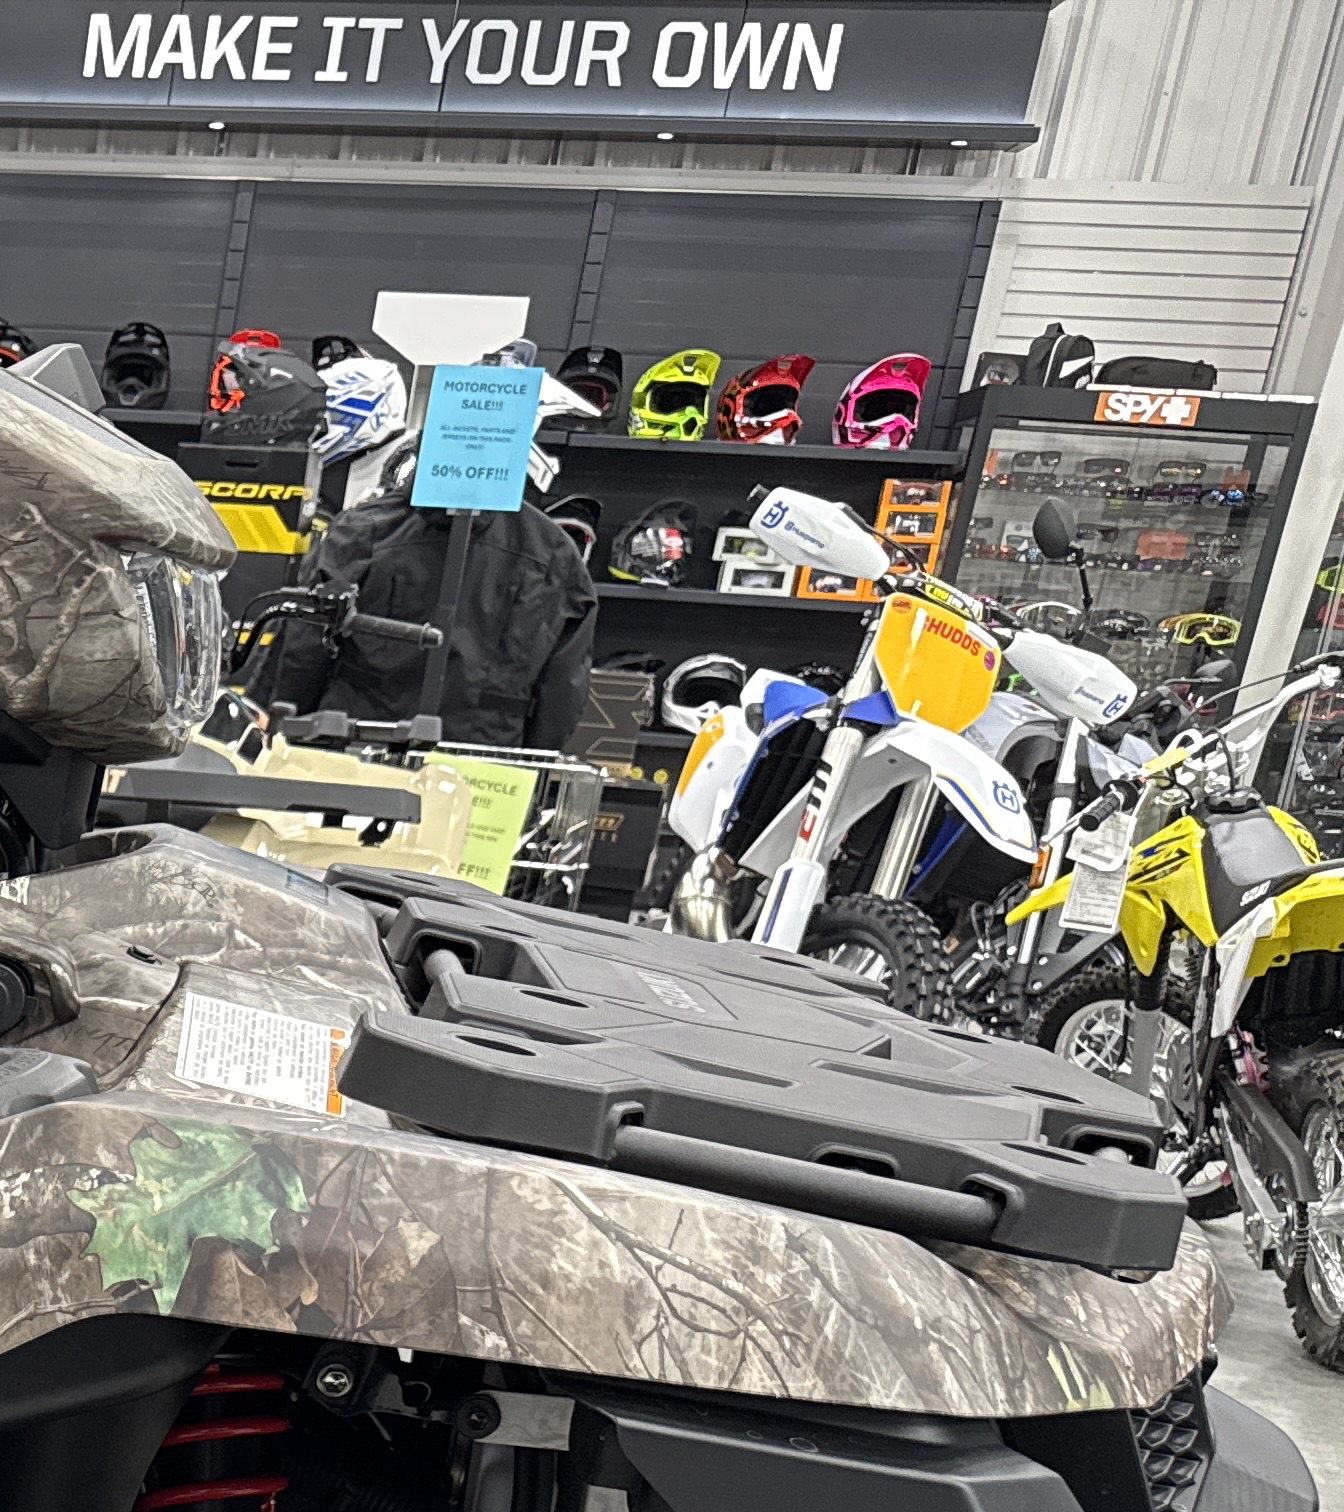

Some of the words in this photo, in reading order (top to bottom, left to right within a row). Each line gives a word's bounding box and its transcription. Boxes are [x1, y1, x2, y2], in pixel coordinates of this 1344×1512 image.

[82, 14, 298, 81] MAKE
[312, 17, 402, 83] IT
[421, 18, 630, 87] YOUR
[651, 21, 844, 92] OWN
[444, 381, 528, 395] MOTORCYCLE
[461, 399, 503, 411] SALE!!!
[431, 464, 462, 479] 50%
[465, 465, 510, 481] OFF!!!
[457, 862, 492, 881] FF!!!
